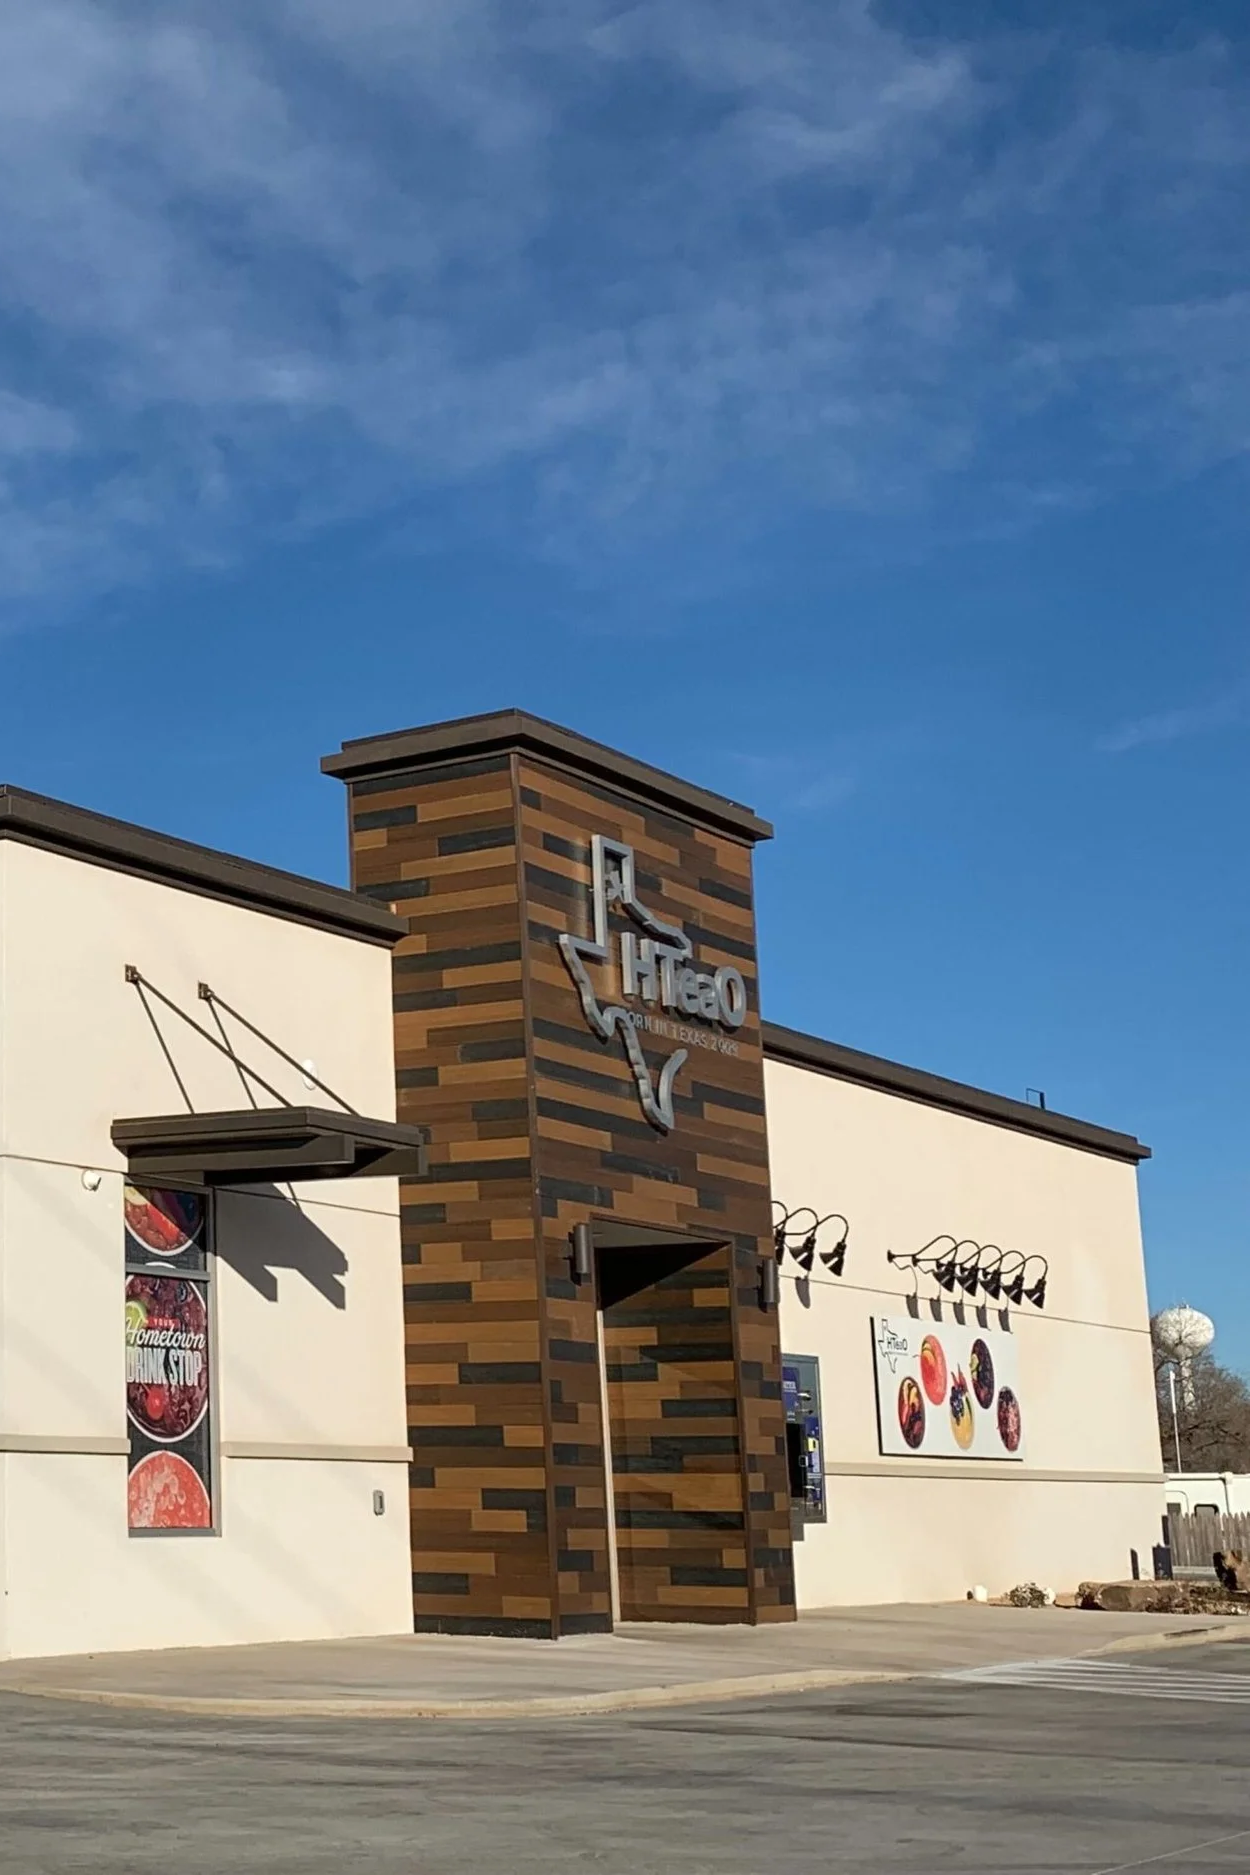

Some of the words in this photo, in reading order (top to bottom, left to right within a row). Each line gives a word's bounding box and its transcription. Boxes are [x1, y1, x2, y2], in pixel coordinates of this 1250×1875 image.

[621, 931, 747, 1028] HTeaO
[626, 1010, 653, 1031] ORN
[670, 1024, 709, 1050] TEXAS
[125, 1316, 206, 1350] Hometown
[126, 1346, 168, 1385] DRINK
[168, 1349, 202, 1387] STOP
